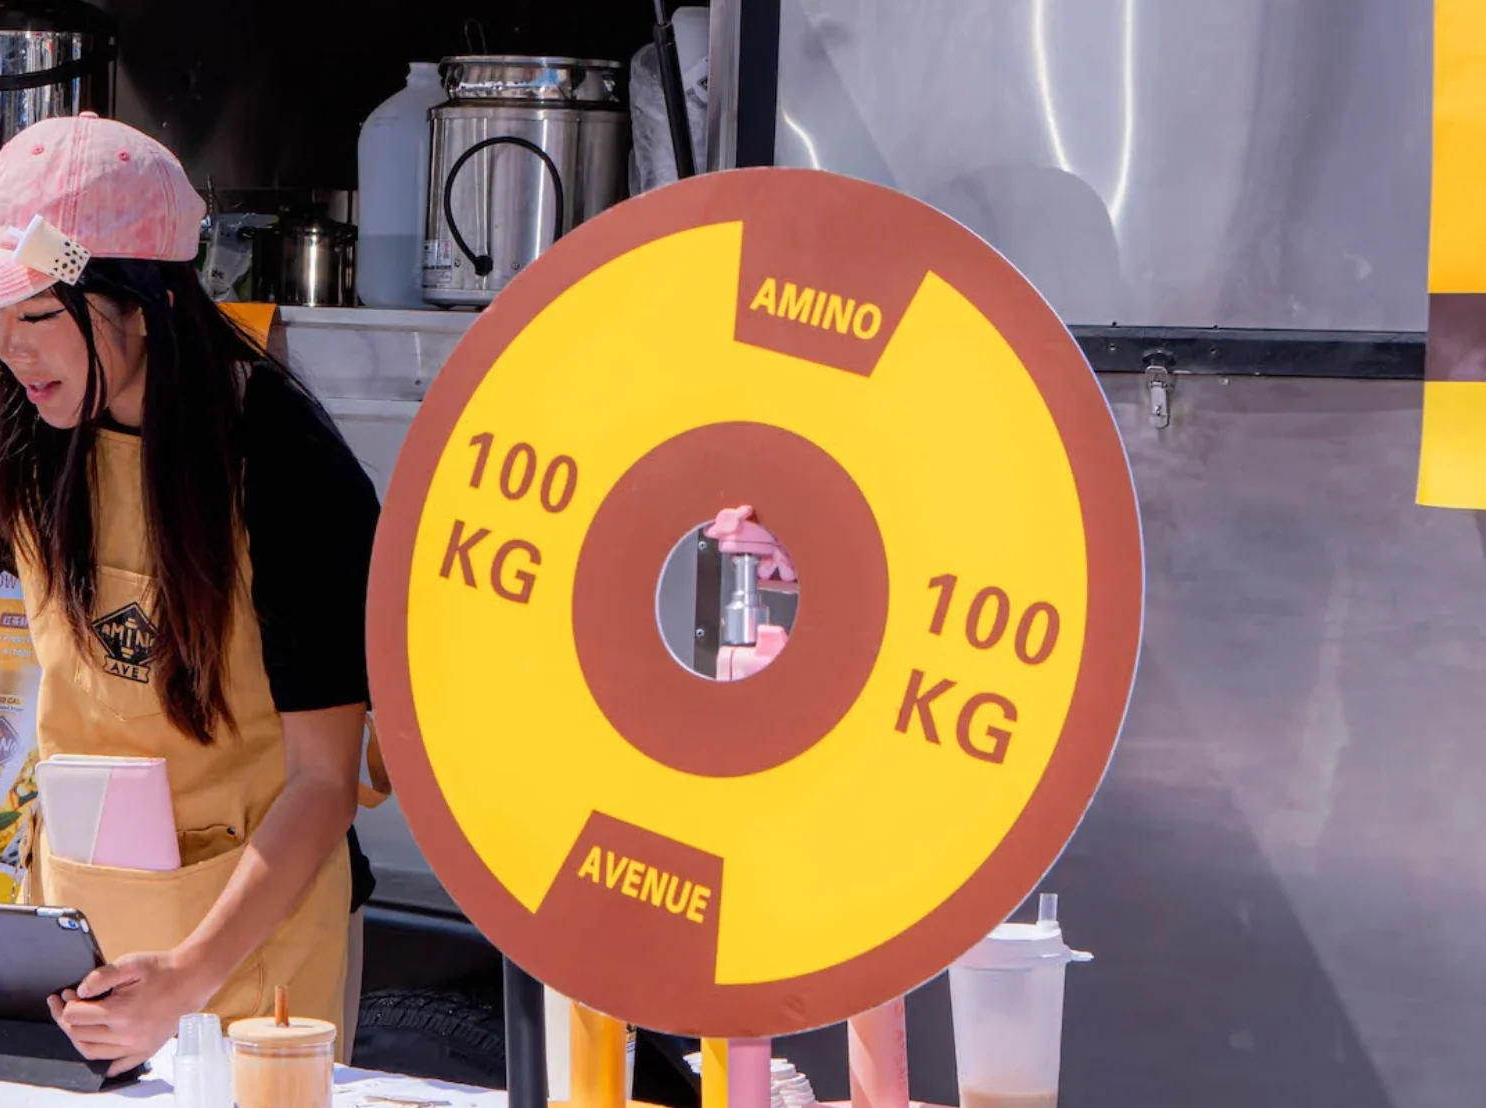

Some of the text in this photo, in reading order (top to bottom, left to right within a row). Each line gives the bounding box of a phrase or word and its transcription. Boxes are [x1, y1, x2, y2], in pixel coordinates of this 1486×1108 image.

[749, 277, 882, 340] AMINO
[468, 431, 578, 514] 100
[440, 519, 543, 605] KG
[927, 573, 1061, 667] 100
[111, 662, 139, 678] AVE
[894, 668, 1018, 765] KG
[577, 846, 711, 923] AVENUE
